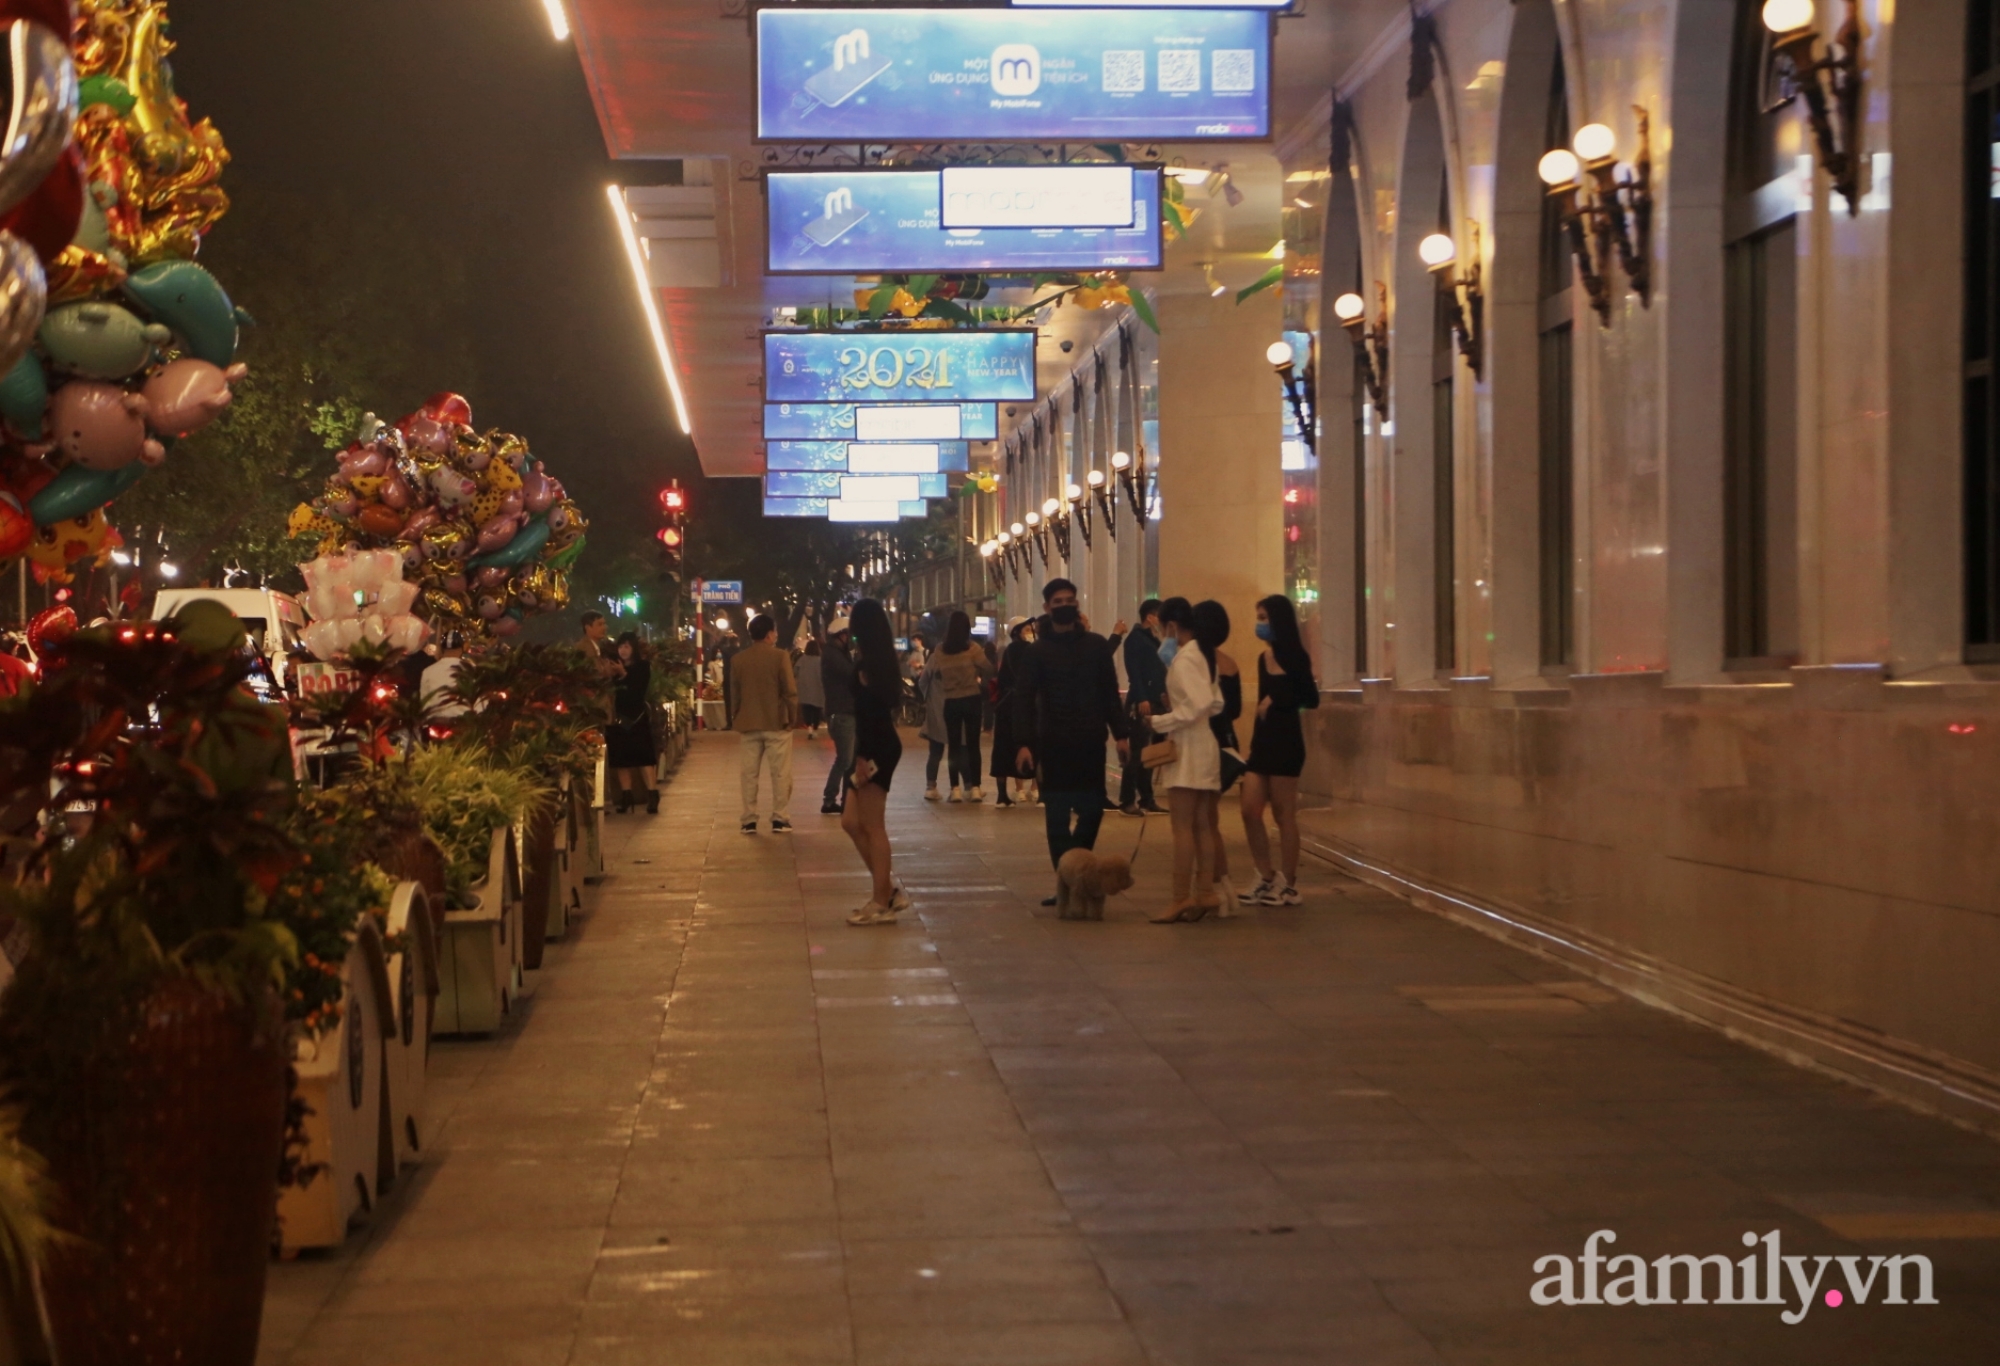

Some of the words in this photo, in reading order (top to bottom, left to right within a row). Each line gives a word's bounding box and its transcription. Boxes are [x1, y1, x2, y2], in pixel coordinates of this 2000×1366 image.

[924, 207, 939, 218] MỘ
[840, 347, 953, 389] 2021
[967, 356, 1018, 369] HAPPY
[967, 368, 990, 377] NEW
[994, 368, 1018, 377] YEAR
[960, 402, 983, 412] PPY
